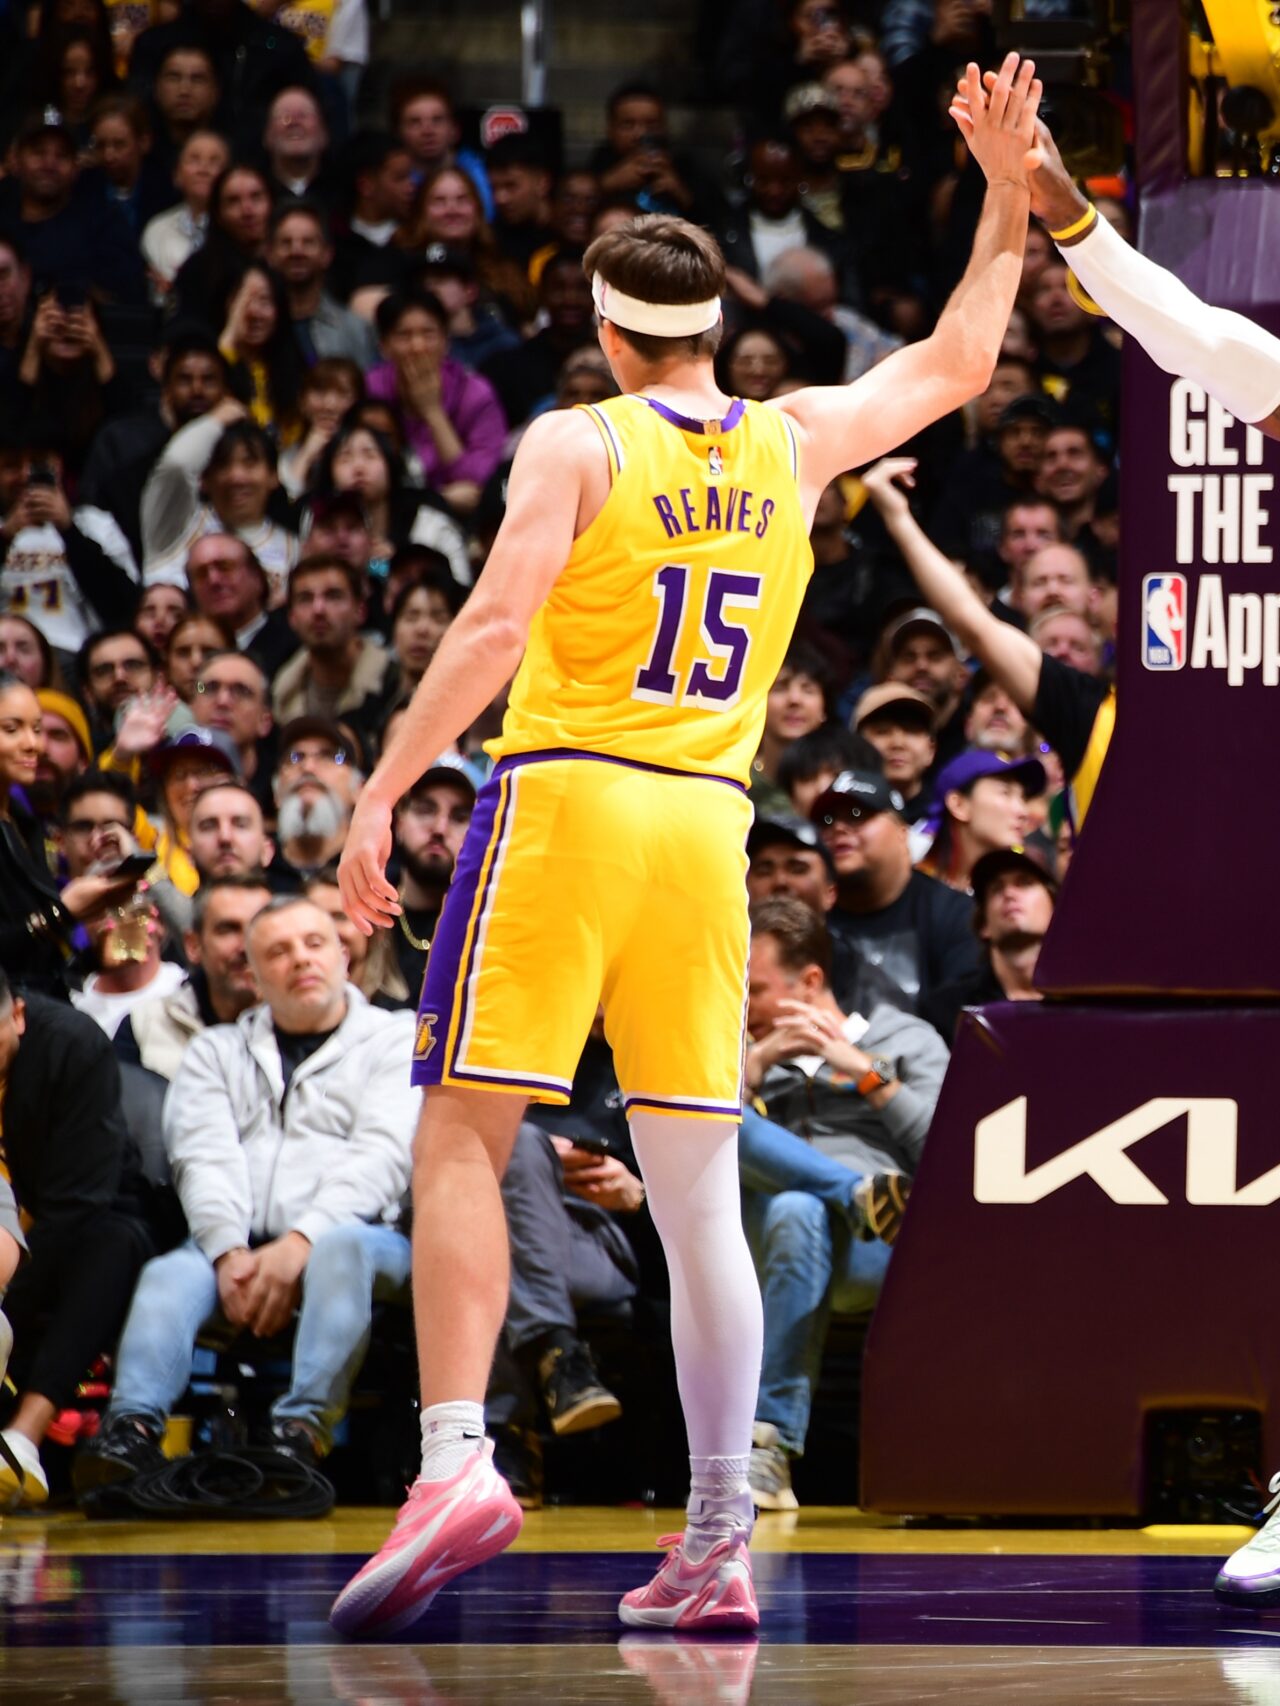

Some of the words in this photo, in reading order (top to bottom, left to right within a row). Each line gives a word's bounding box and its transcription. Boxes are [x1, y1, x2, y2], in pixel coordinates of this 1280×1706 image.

[653, 486, 776, 539] REAVES
[1167, 474, 1275, 564] THE
[629, 561, 765, 714] 15
